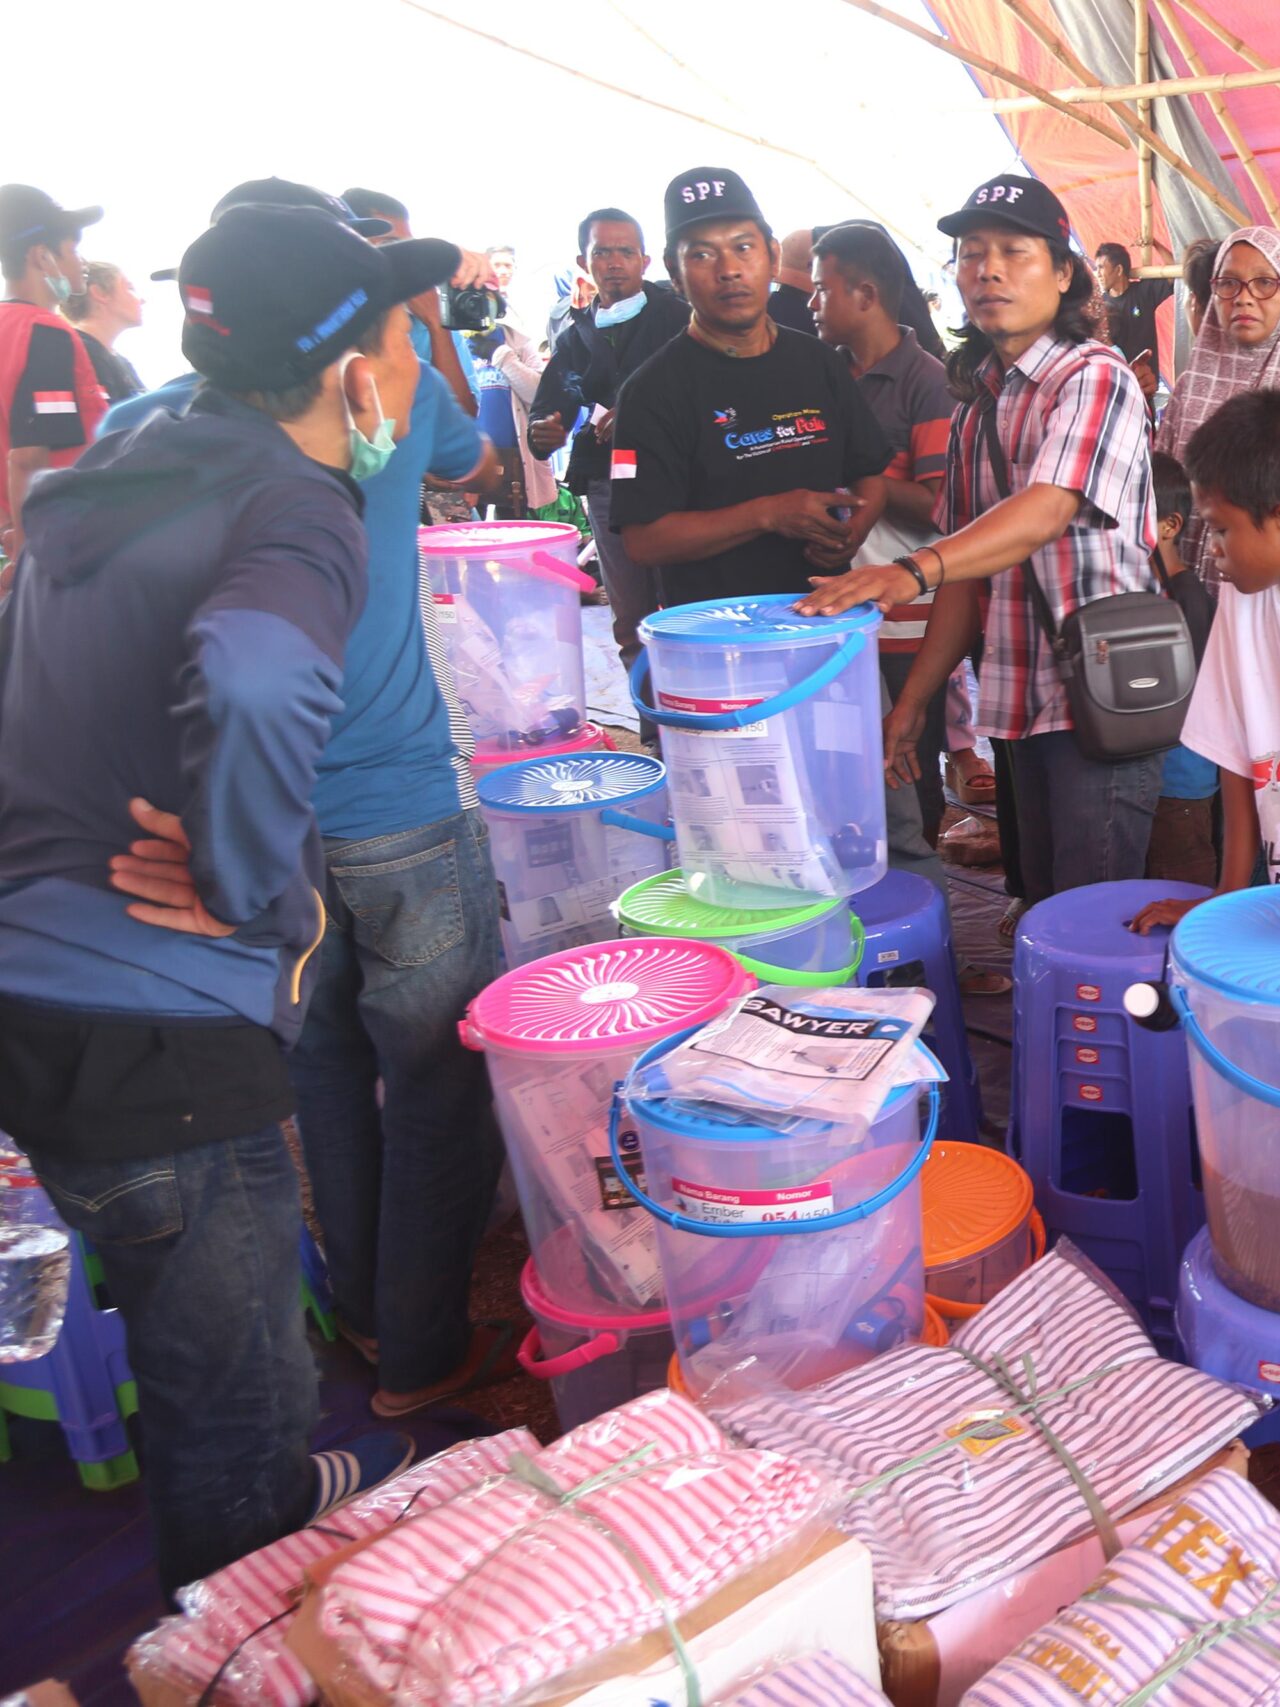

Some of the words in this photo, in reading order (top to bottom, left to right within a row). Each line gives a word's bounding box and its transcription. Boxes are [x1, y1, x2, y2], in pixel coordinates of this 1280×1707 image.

[682, 180, 726, 204] SPF
[976, 185, 1024, 204] SPF
[724, 428, 775, 449] Cares
[776, 425, 796, 438] for
[721, 702, 749, 711] Nomor
[744, 999, 871, 1035] SAWYER
[679, 1183, 704, 1198] Nama
[705, 1190, 740, 1205] Barang
[776, 1189, 813, 1201] Nomor
[702, 1202, 745, 1218] Ember
[1143, 1503, 1258, 1609] TEX
